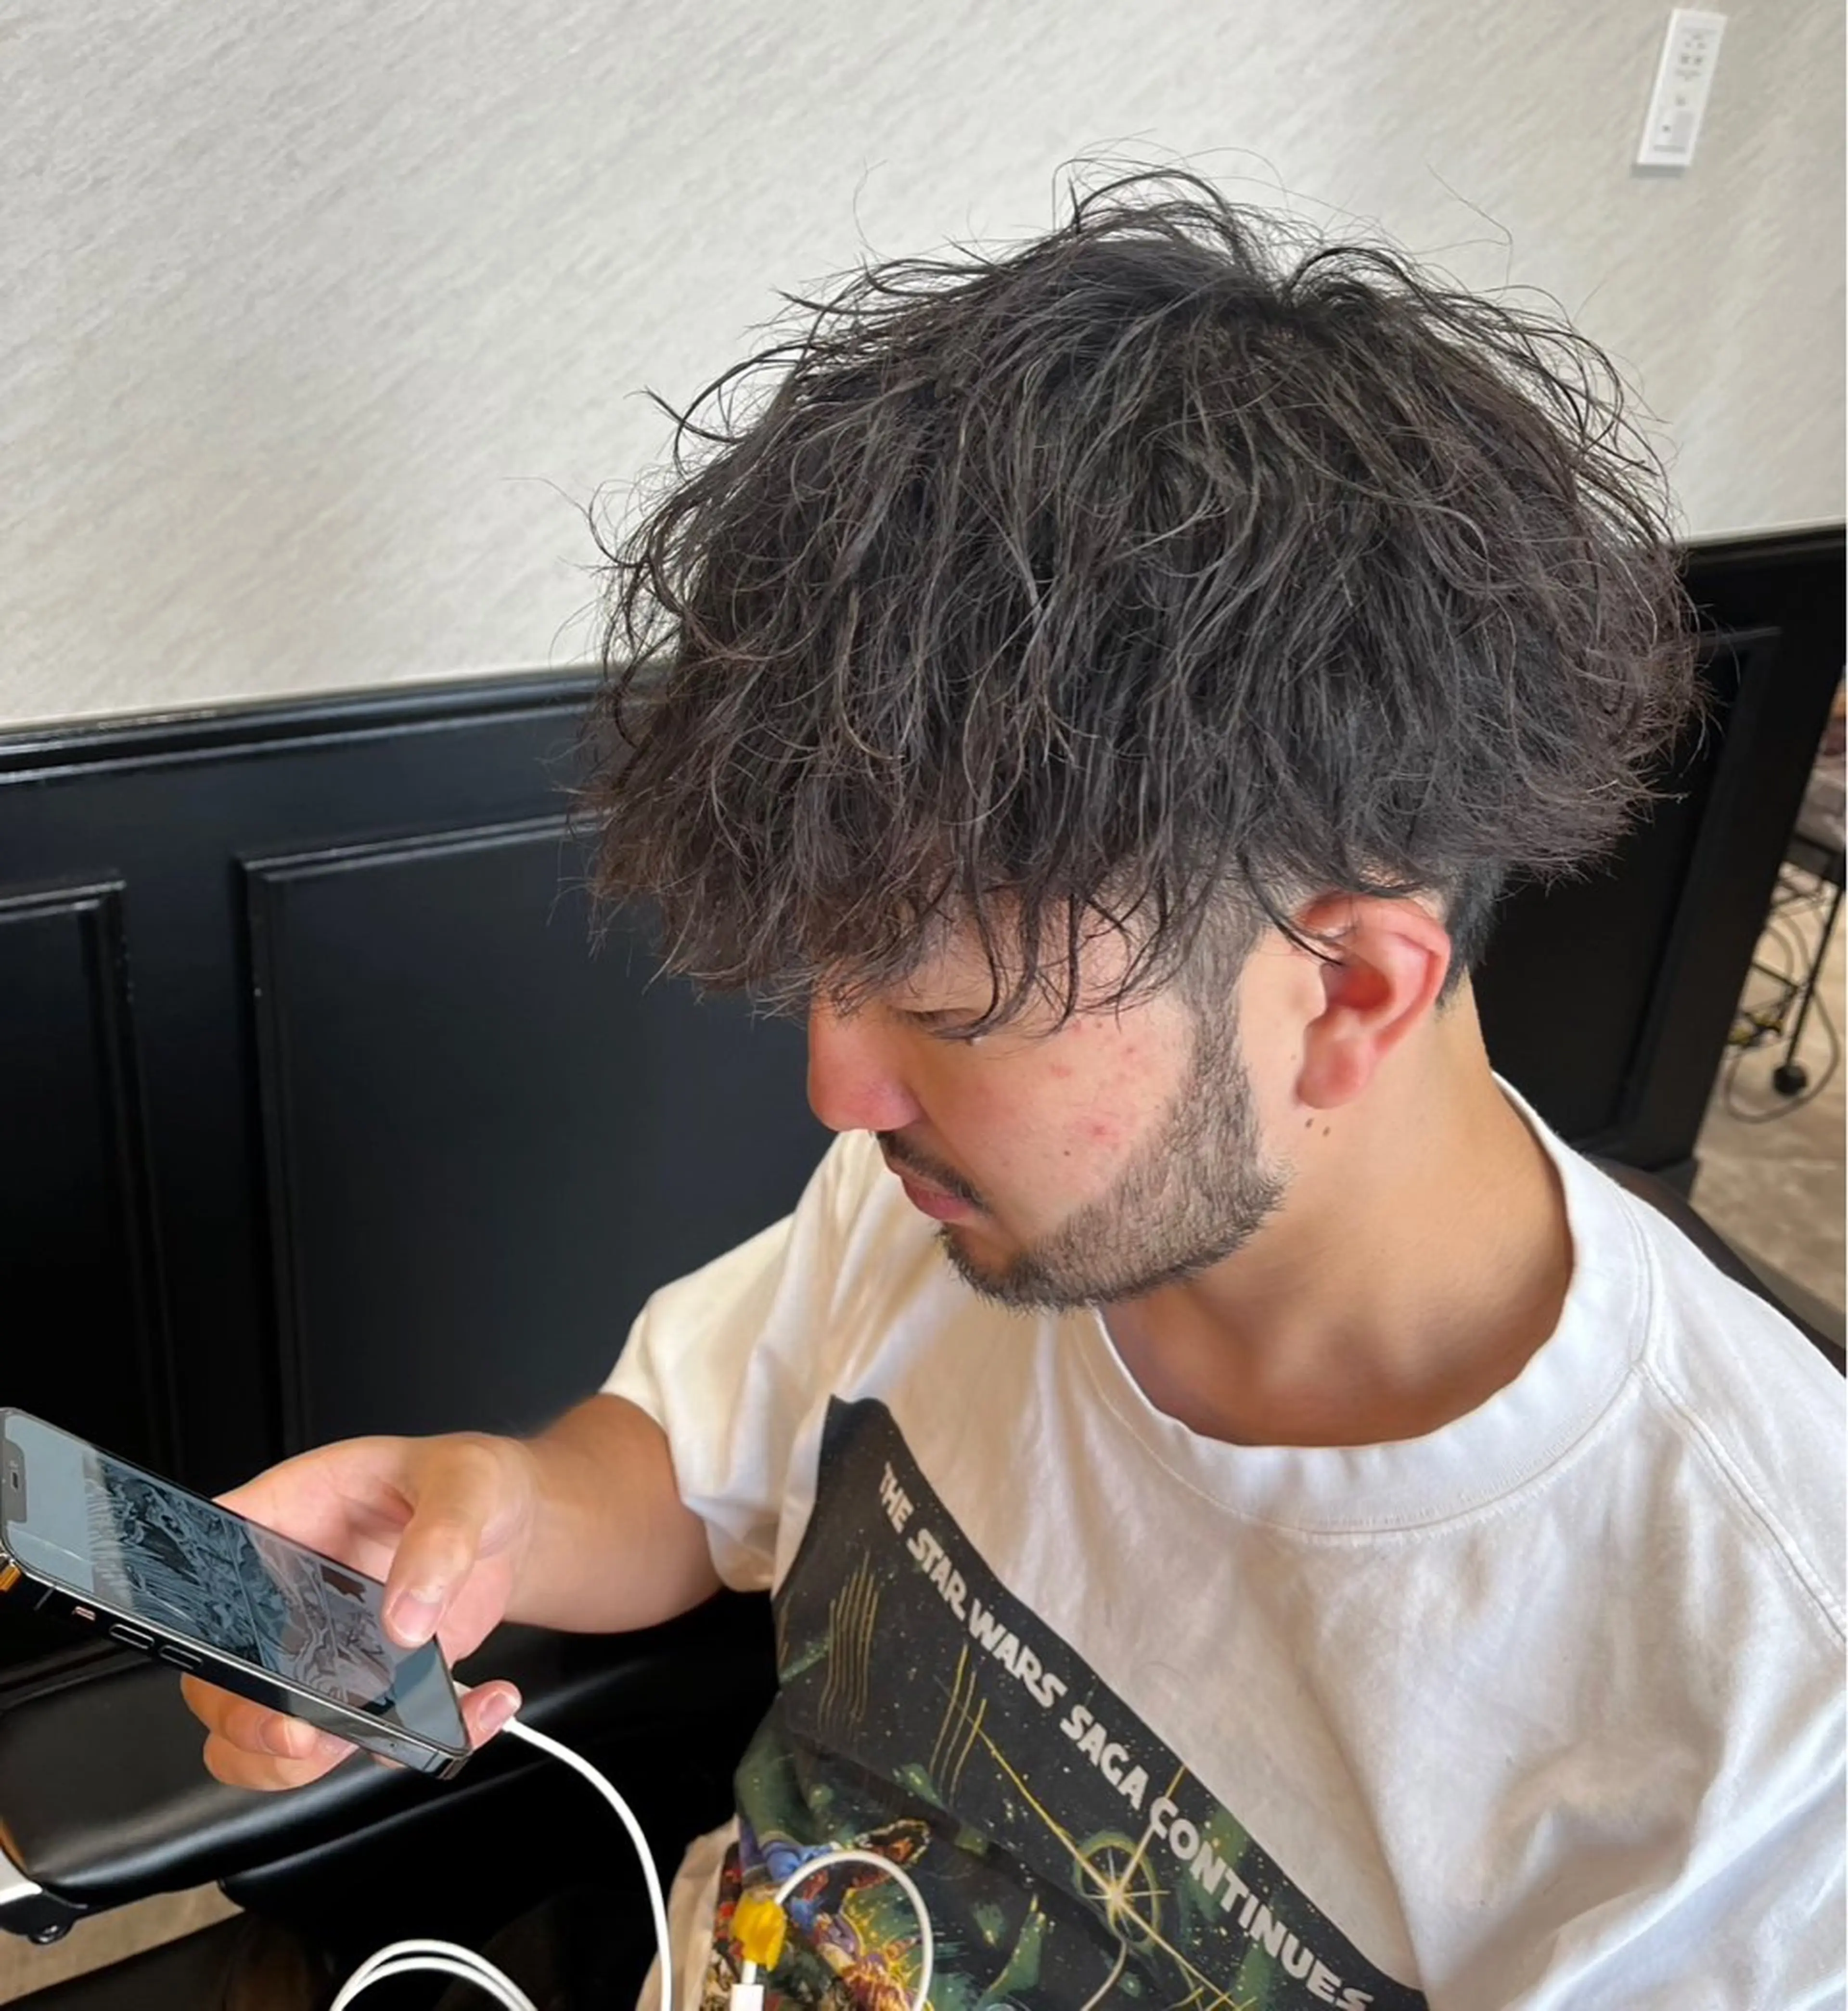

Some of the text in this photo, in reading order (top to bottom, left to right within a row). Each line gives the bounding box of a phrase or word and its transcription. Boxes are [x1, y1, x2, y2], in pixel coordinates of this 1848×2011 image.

[879, 1461, 1374, 2011] THE STAR WARS SAGA CONTINUES
